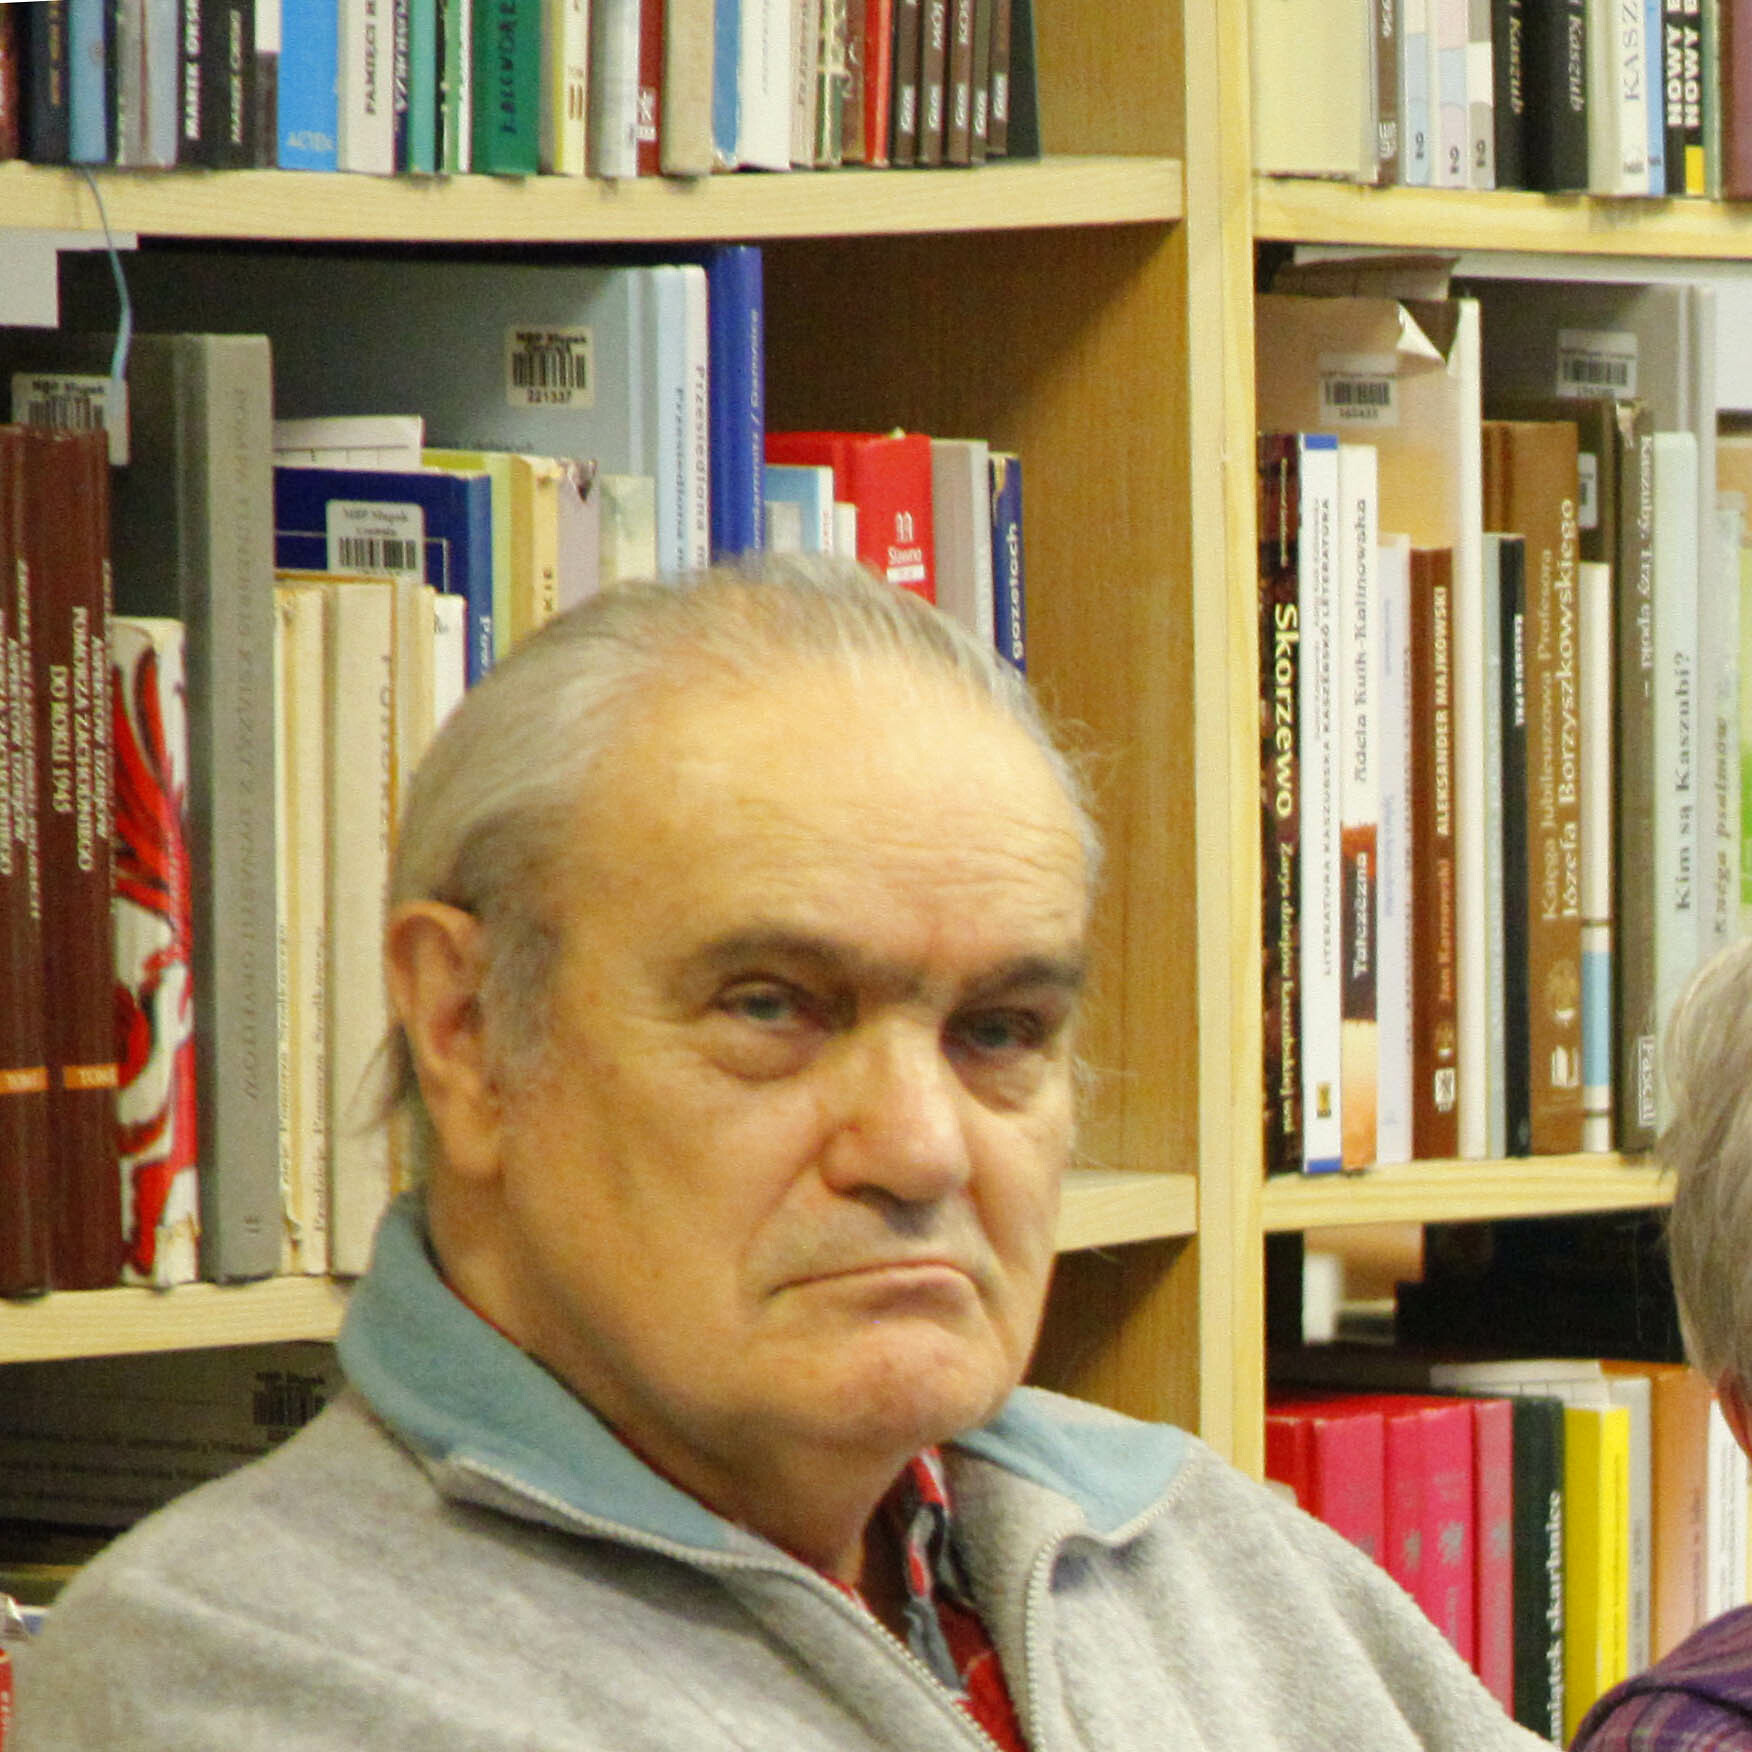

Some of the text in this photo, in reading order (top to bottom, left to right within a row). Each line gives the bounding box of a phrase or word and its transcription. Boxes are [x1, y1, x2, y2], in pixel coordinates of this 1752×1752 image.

[1665, 24, 1683, 127] NOWY
[1683, 27, 1702, 128] NOWY
[1433, 586, 1449, 707] MAJKOWSKI
[1537, 548, 1552, 661] Profesora
[50, 664, 74, 815] DO ROKU 1945
[72, 606, 93, 871] POMORZA ZACHODNIEGO
[1274, 602, 1300, 818] Skorzewo
[1434, 709, 1450, 836] ALEKSANDER
[1539, 672, 1556, 828] Jubileuszowa
[1554, 499, 1579, 918] Józefa Borzyszkowskiego
[1673, 651, 1692, 911] Kim są Kaszubi?
